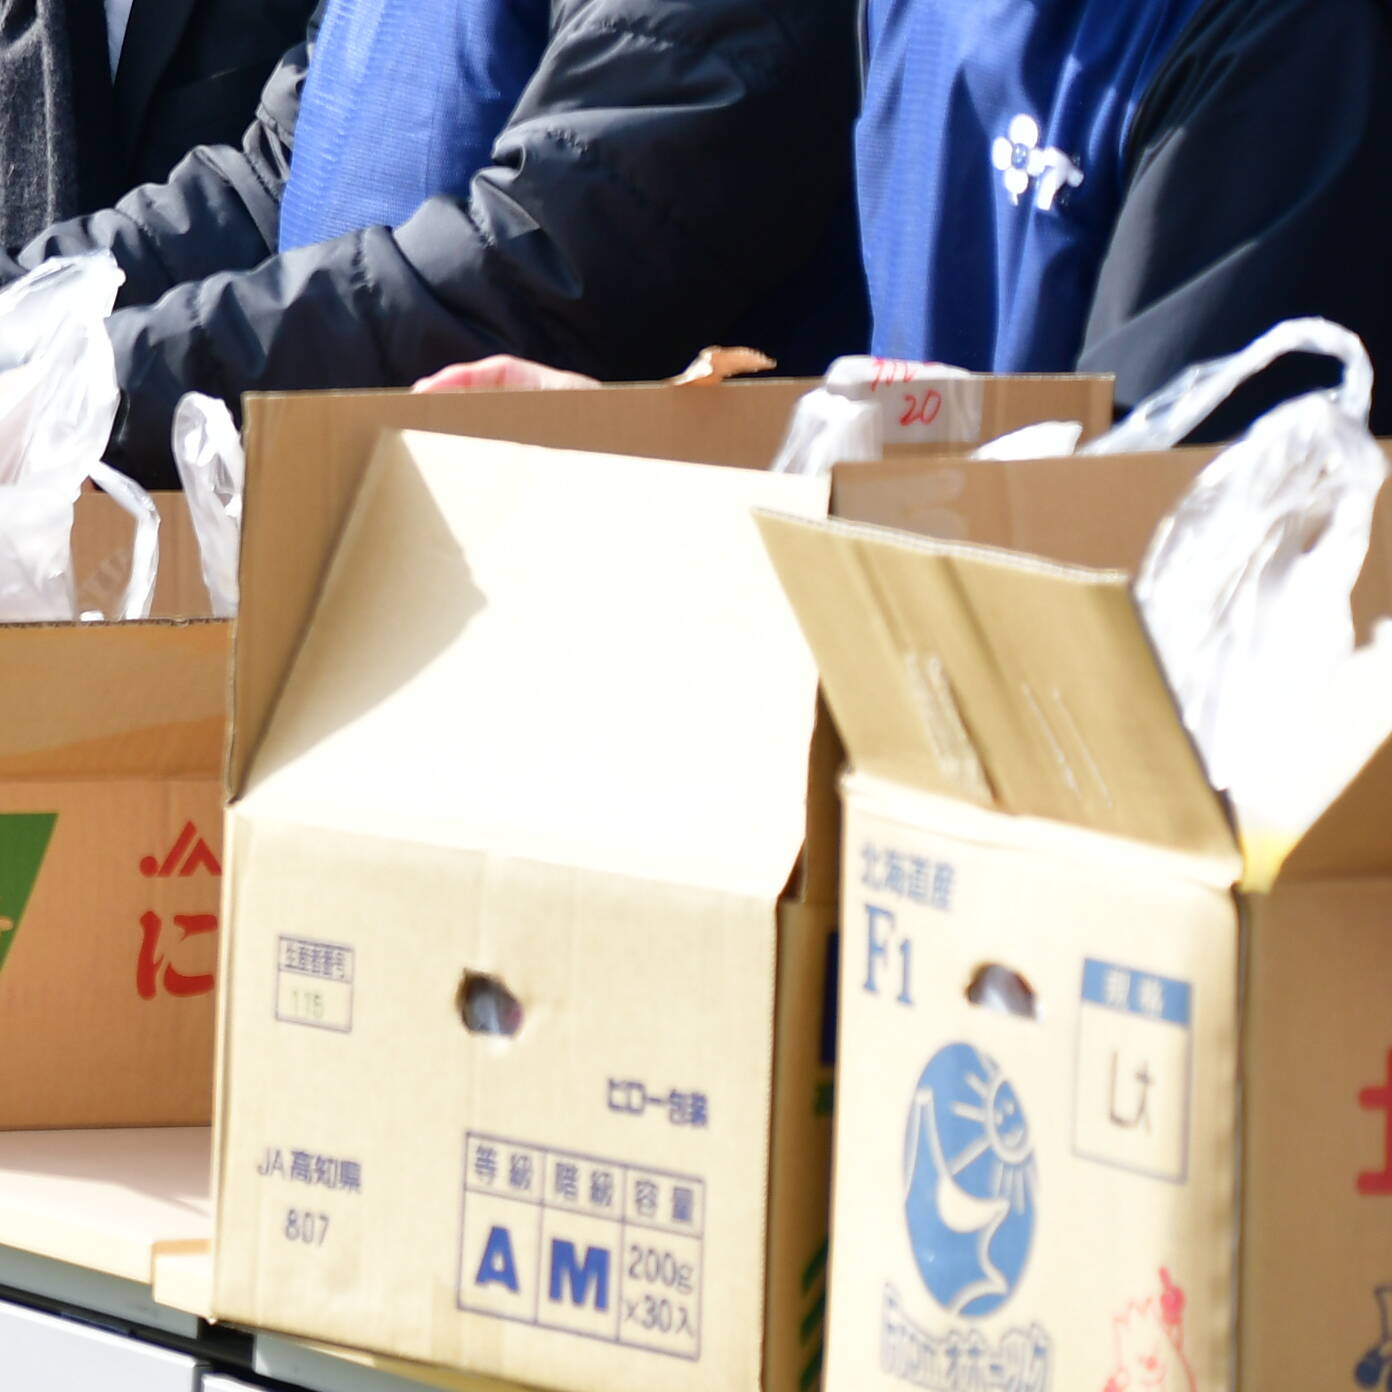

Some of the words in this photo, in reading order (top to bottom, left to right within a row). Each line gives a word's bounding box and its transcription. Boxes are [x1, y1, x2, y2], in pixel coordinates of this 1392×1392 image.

[899, 389, 943, 427] 20
[863, 903, 916, 1006] F1
[607, 1077, 708, 1127] ヒロー包装
[257, 1148, 362, 1196] JA高知県
[473, 1144, 535, 1192] 等級
[554, 1162, 616, 1209] 階級
[634, 1180, 696, 1225] 容量
[284, 1211, 330, 1250] 807
[473, 1225, 521, 1296] A
[548, 1239, 611, 1313] M
[628, 1243, 695, 1296] 200g
